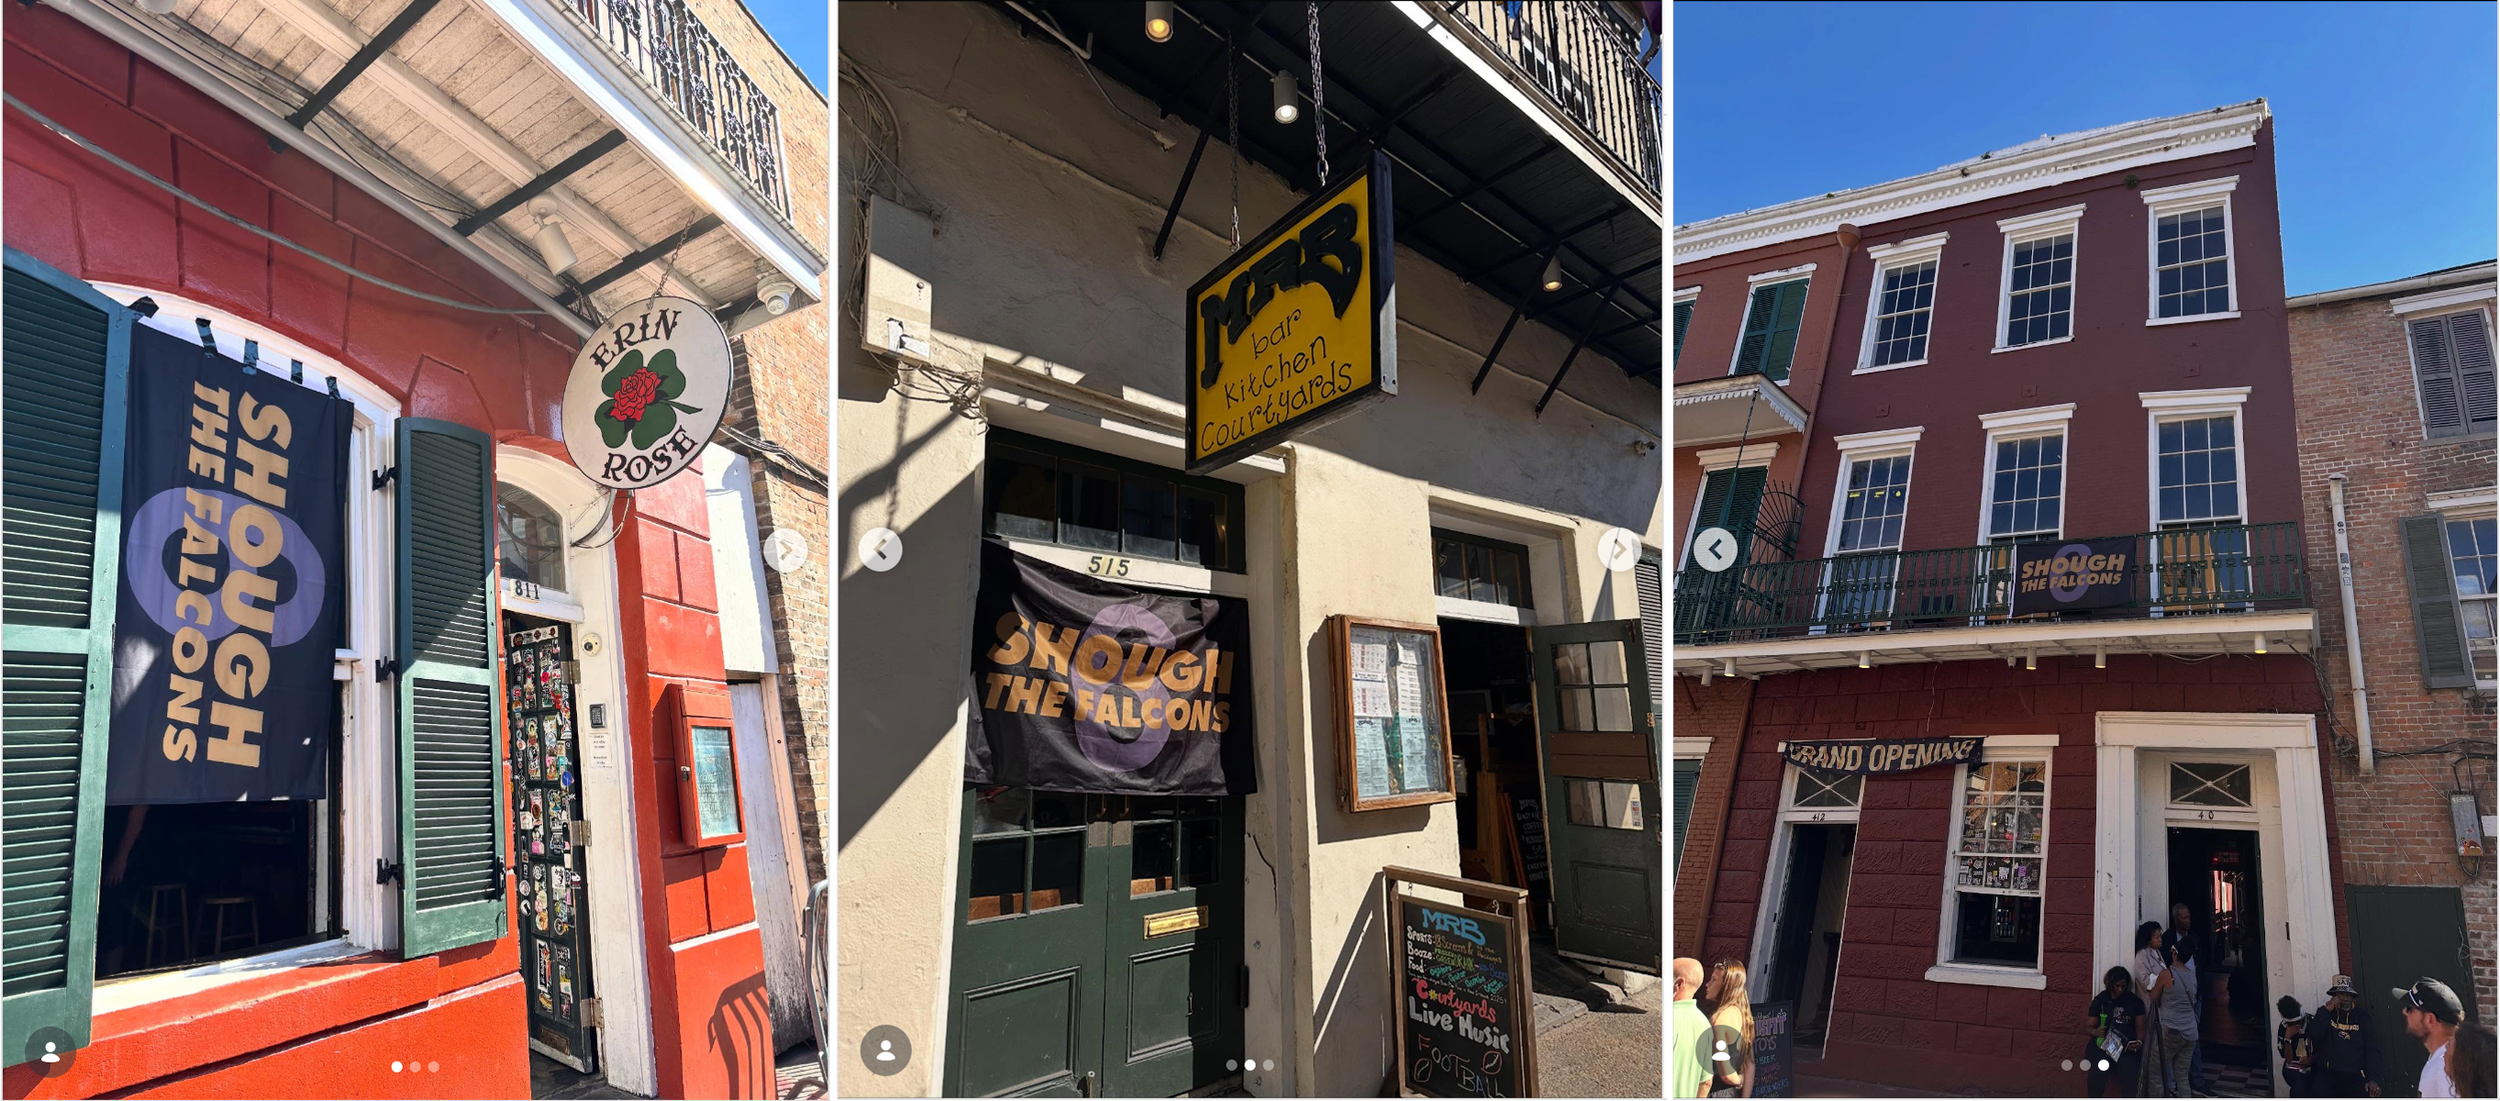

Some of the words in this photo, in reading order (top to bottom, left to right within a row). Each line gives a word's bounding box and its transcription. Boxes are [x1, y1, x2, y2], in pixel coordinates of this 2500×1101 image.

[1200, 203, 1362, 390] MRB
[589, 308, 682, 373] ERIN
[1252, 308, 1302, 360] bar
[188, 381, 230, 483] THE
[1201, 363, 1353, 452] Courtyards
[601, 425, 699, 483] ROSE
[207, 391, 292, 768] SHOUGH
[515, 580, 540, 600] 811
[1088, 556, 1131, 577] 515
[2021, 553, 2126, 579] SHOUGH
[2021, 578, 2048, 593] THE
[2050, 572, 2122, 589] FALCONS
[162, 486, 223, 763] FALCONS
[986, 612, 1234, 694] SHOUGH
[984, 672, 1069, 718] THE
[1074, 689, 1231, 733] FALCONS
[1789, 743, 1864, 771] GRAND
[1868, 739, 1976, 771] OPENING
[1422, 908, 1486, 946] MRB
[1408, 996, 1454, 1032] Live
[1459, 1014, 1510, 1054] Music
[1755, 1016, 1787, 1036] ISFIT
